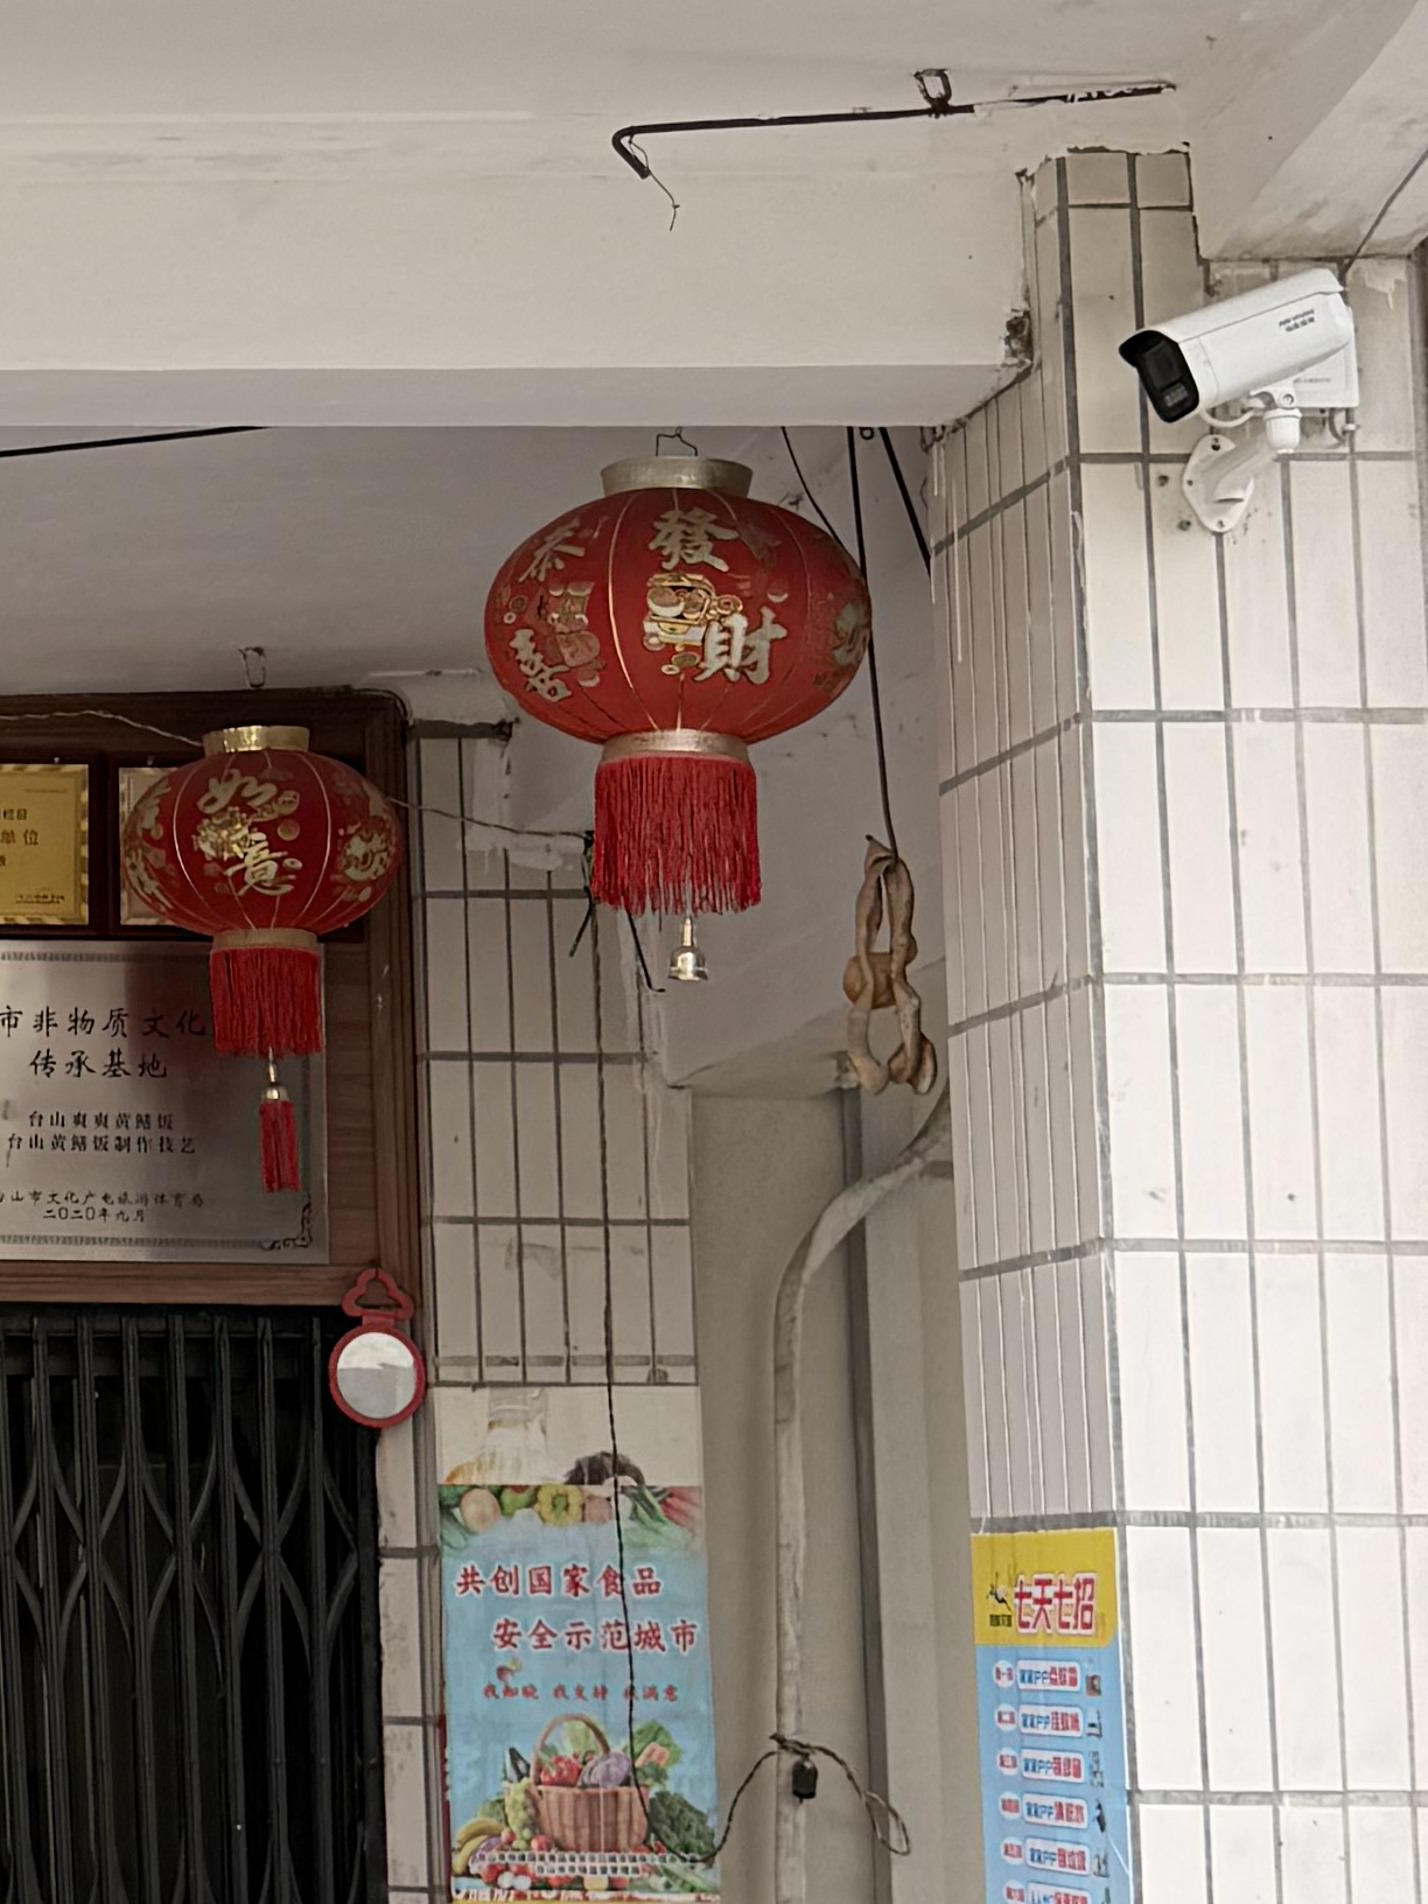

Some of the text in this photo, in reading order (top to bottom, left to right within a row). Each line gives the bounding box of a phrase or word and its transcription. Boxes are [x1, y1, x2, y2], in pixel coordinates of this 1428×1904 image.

[28, 1048, 169, 1079] 传承基地
[28, 1110, 175, 1131] 台山爽爽黄鳝饭
[7, 1132, 196, 1156] 台山黄鳝饭制作技艺
[455, 1562, 663, 1598] 共创国家食品
[1014, 1576, 1096, 1631] 七天七招
[492, 1618, 698, 1655] 安全示范城市
